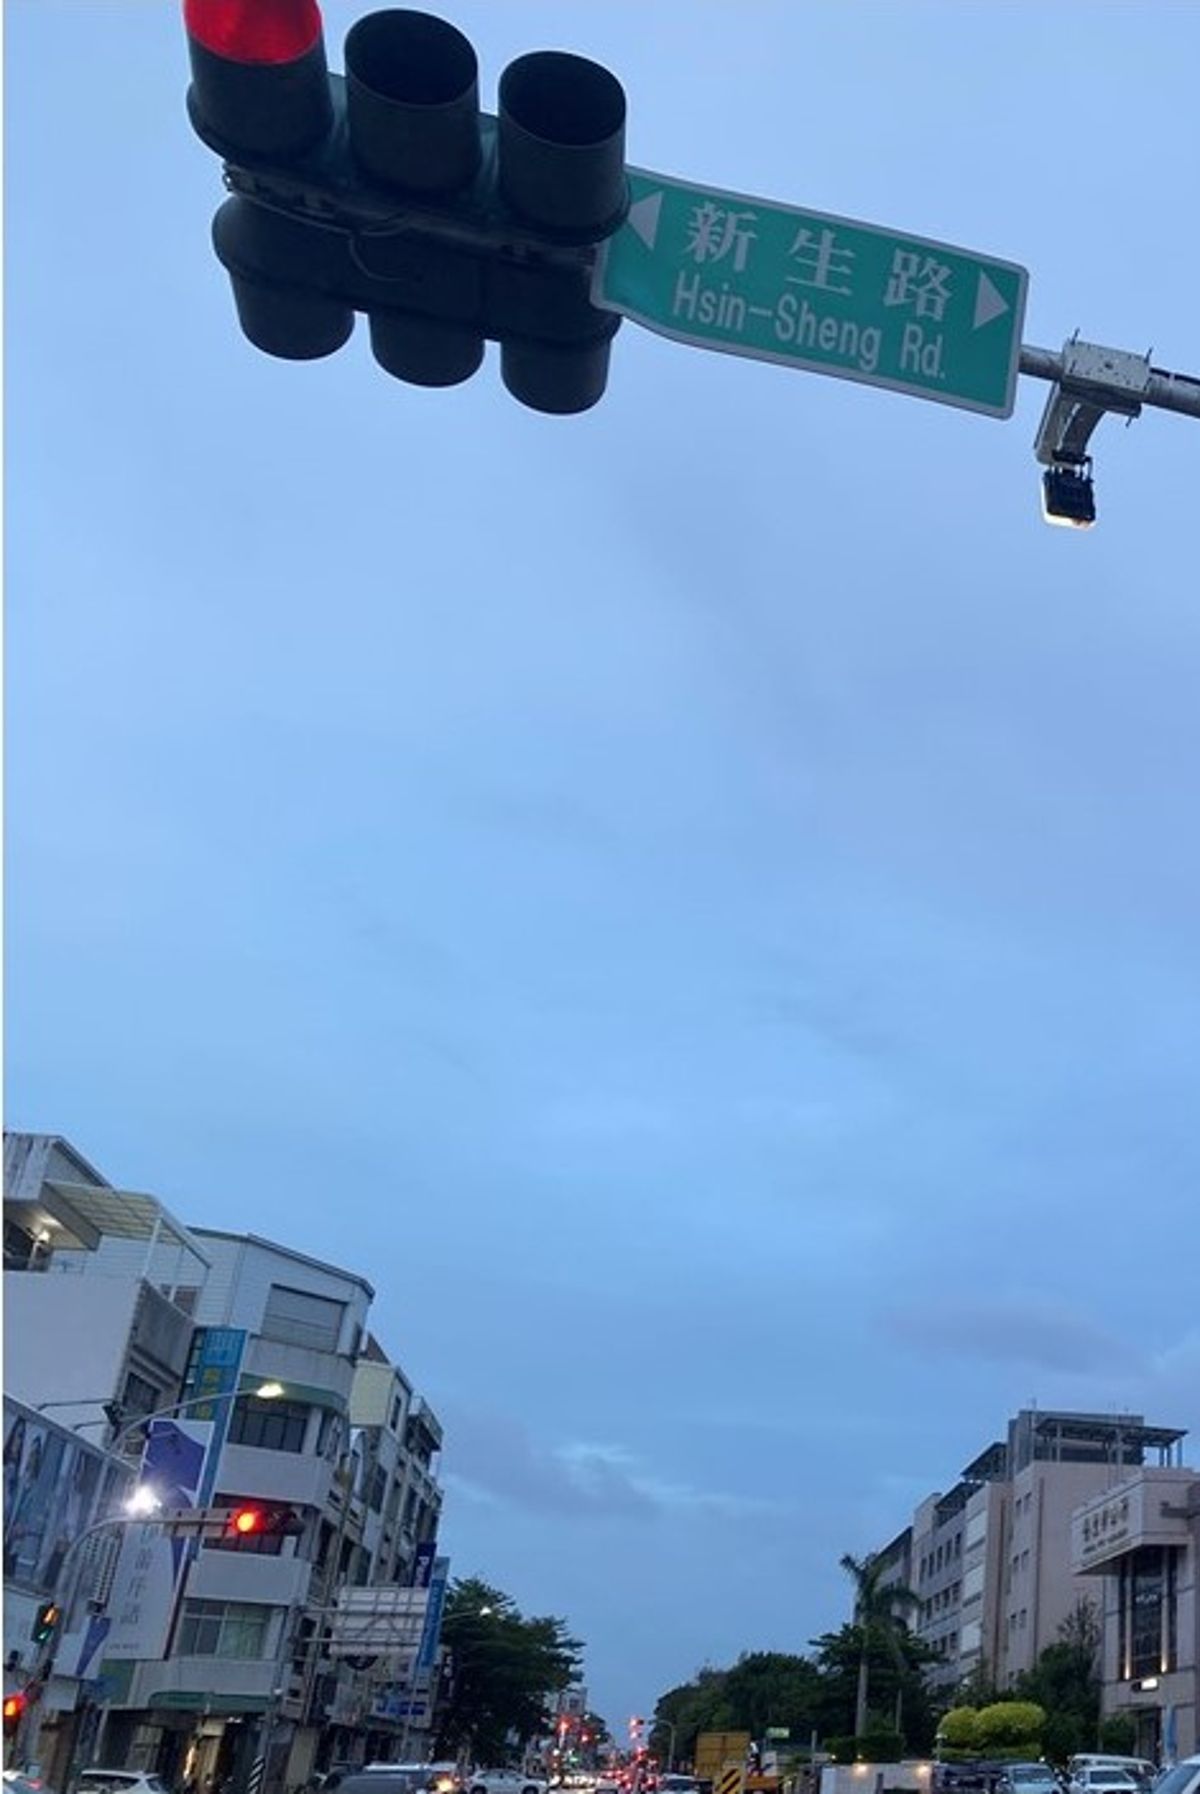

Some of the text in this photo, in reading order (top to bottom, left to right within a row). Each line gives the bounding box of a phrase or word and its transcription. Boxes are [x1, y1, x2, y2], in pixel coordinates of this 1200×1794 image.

[685, 202, 953, 322] 新生路
[672, 271, 947, 379] Hsin-Sheng Rd.
